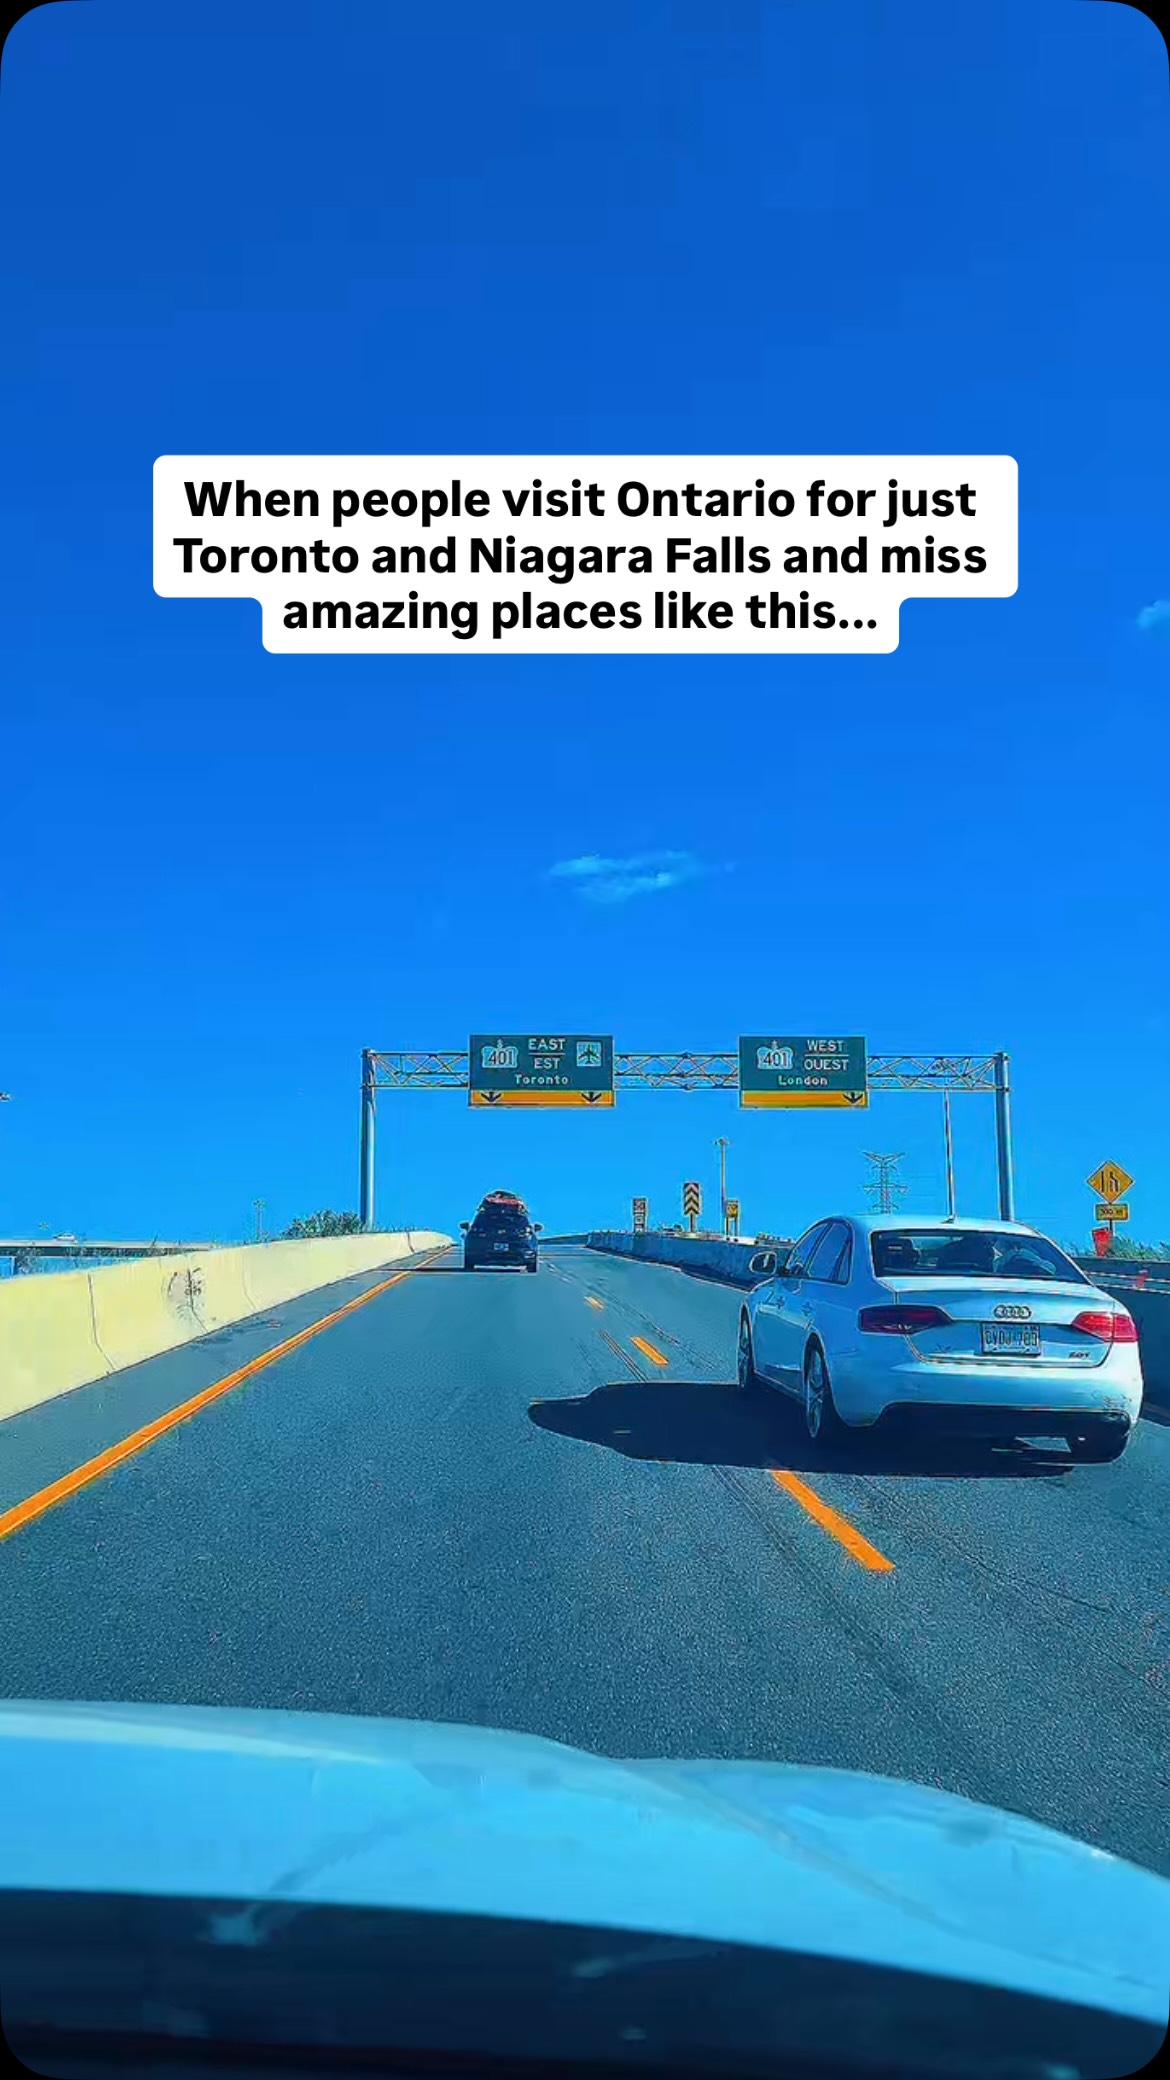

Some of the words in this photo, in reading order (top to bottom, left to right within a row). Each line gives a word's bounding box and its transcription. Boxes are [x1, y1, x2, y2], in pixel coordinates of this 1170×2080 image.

[528, 1038, 566, 1050] EAST
[807, 1039, 845, 1051] WEST
[488, 1050, 514, 1065] 401
[534, 1057, 561, 1069] EST
[763, 1051, 788, 1066] 401
[804, 1059, 849, 1070] OUEST
[514, 1073, 569, 1085] Toronto
[778, 1075, 828, 1085] London
